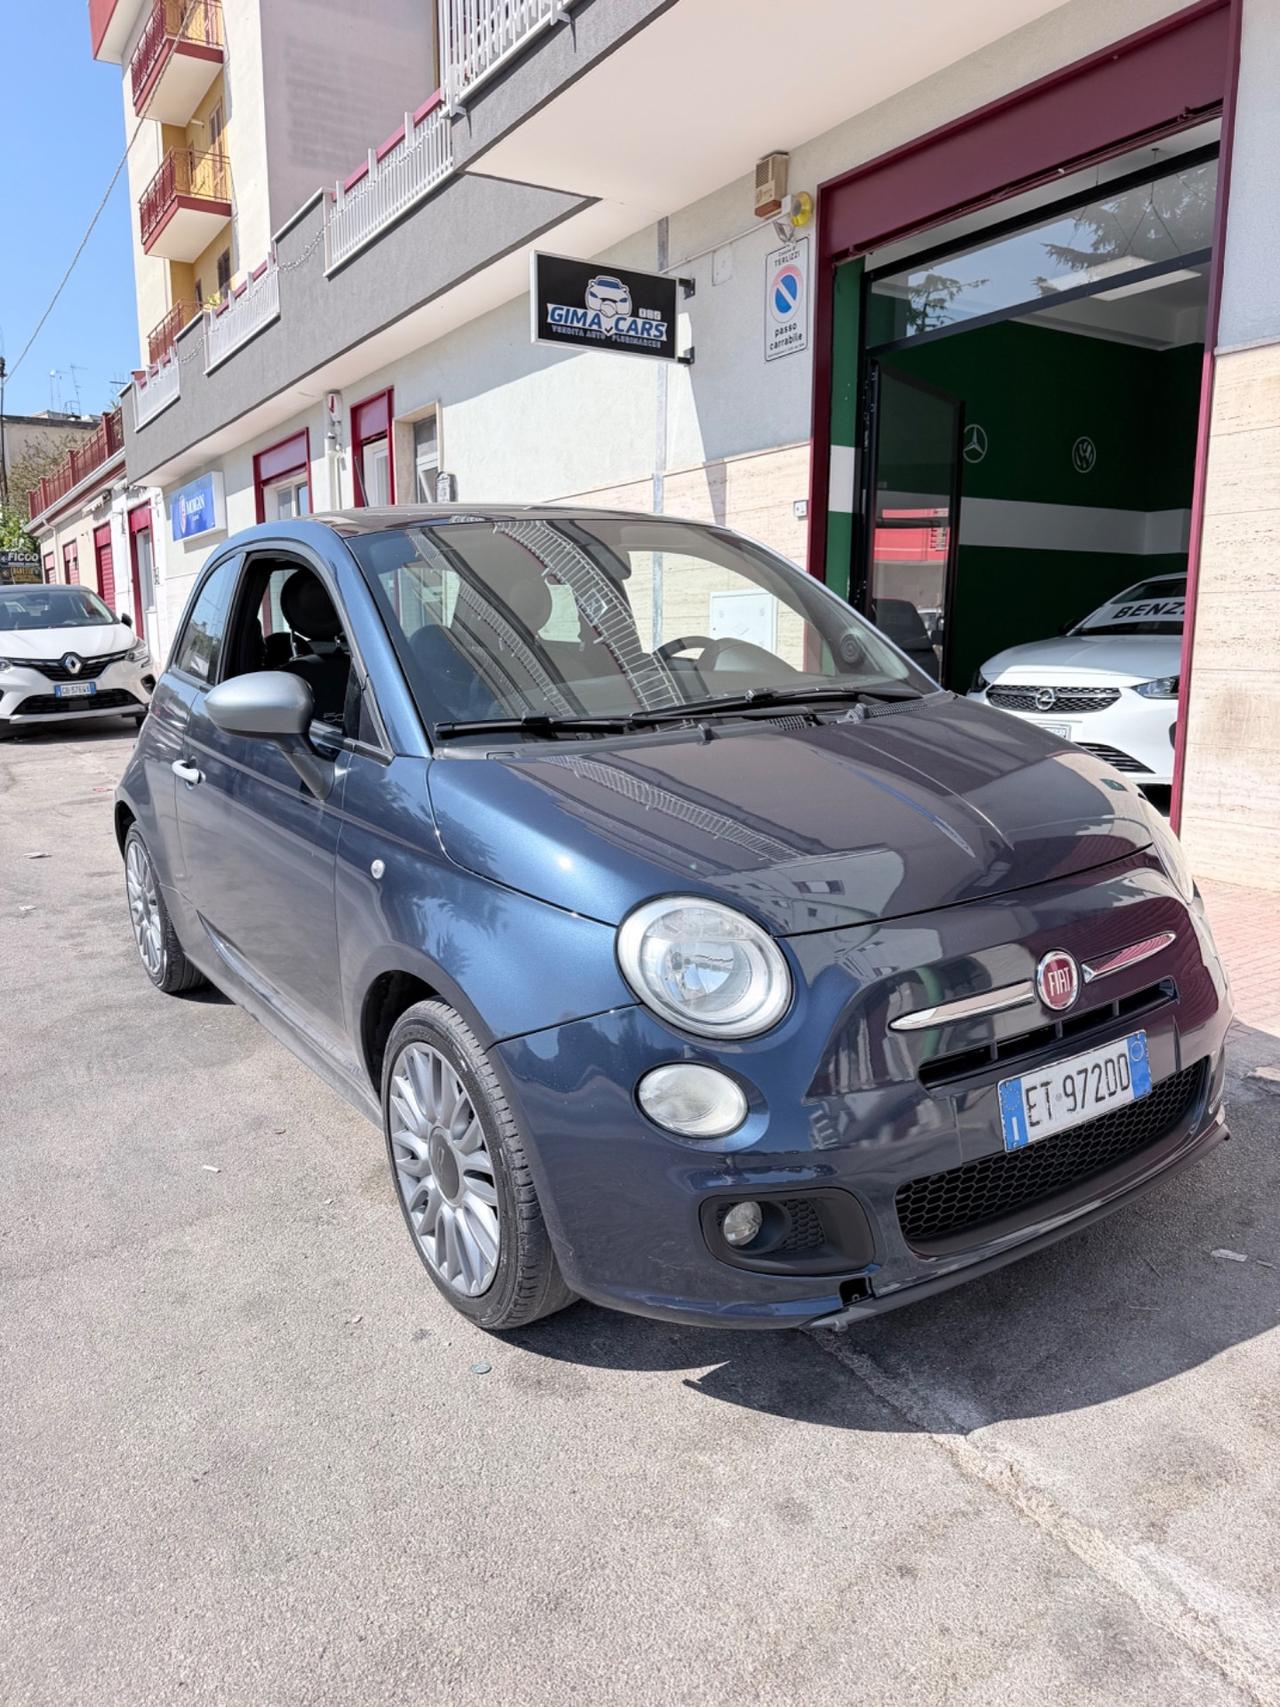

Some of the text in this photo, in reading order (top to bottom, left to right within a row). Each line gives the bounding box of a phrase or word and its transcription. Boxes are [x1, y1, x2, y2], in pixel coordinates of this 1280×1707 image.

[775, 250, 800, 267] TERLIZZI
[550, 306, 665, 339] GIMA CARS
[774, 322, 797, 338] passo
[769, 332, 802, 350] carrabile
[1112, 602, 1185, 619] BENZ
[1047, 966, 1071, 997] FIAT
[1025, 1081, 1053, 1127] ET
[1062, 1053, 1131, 1113] 972DD
